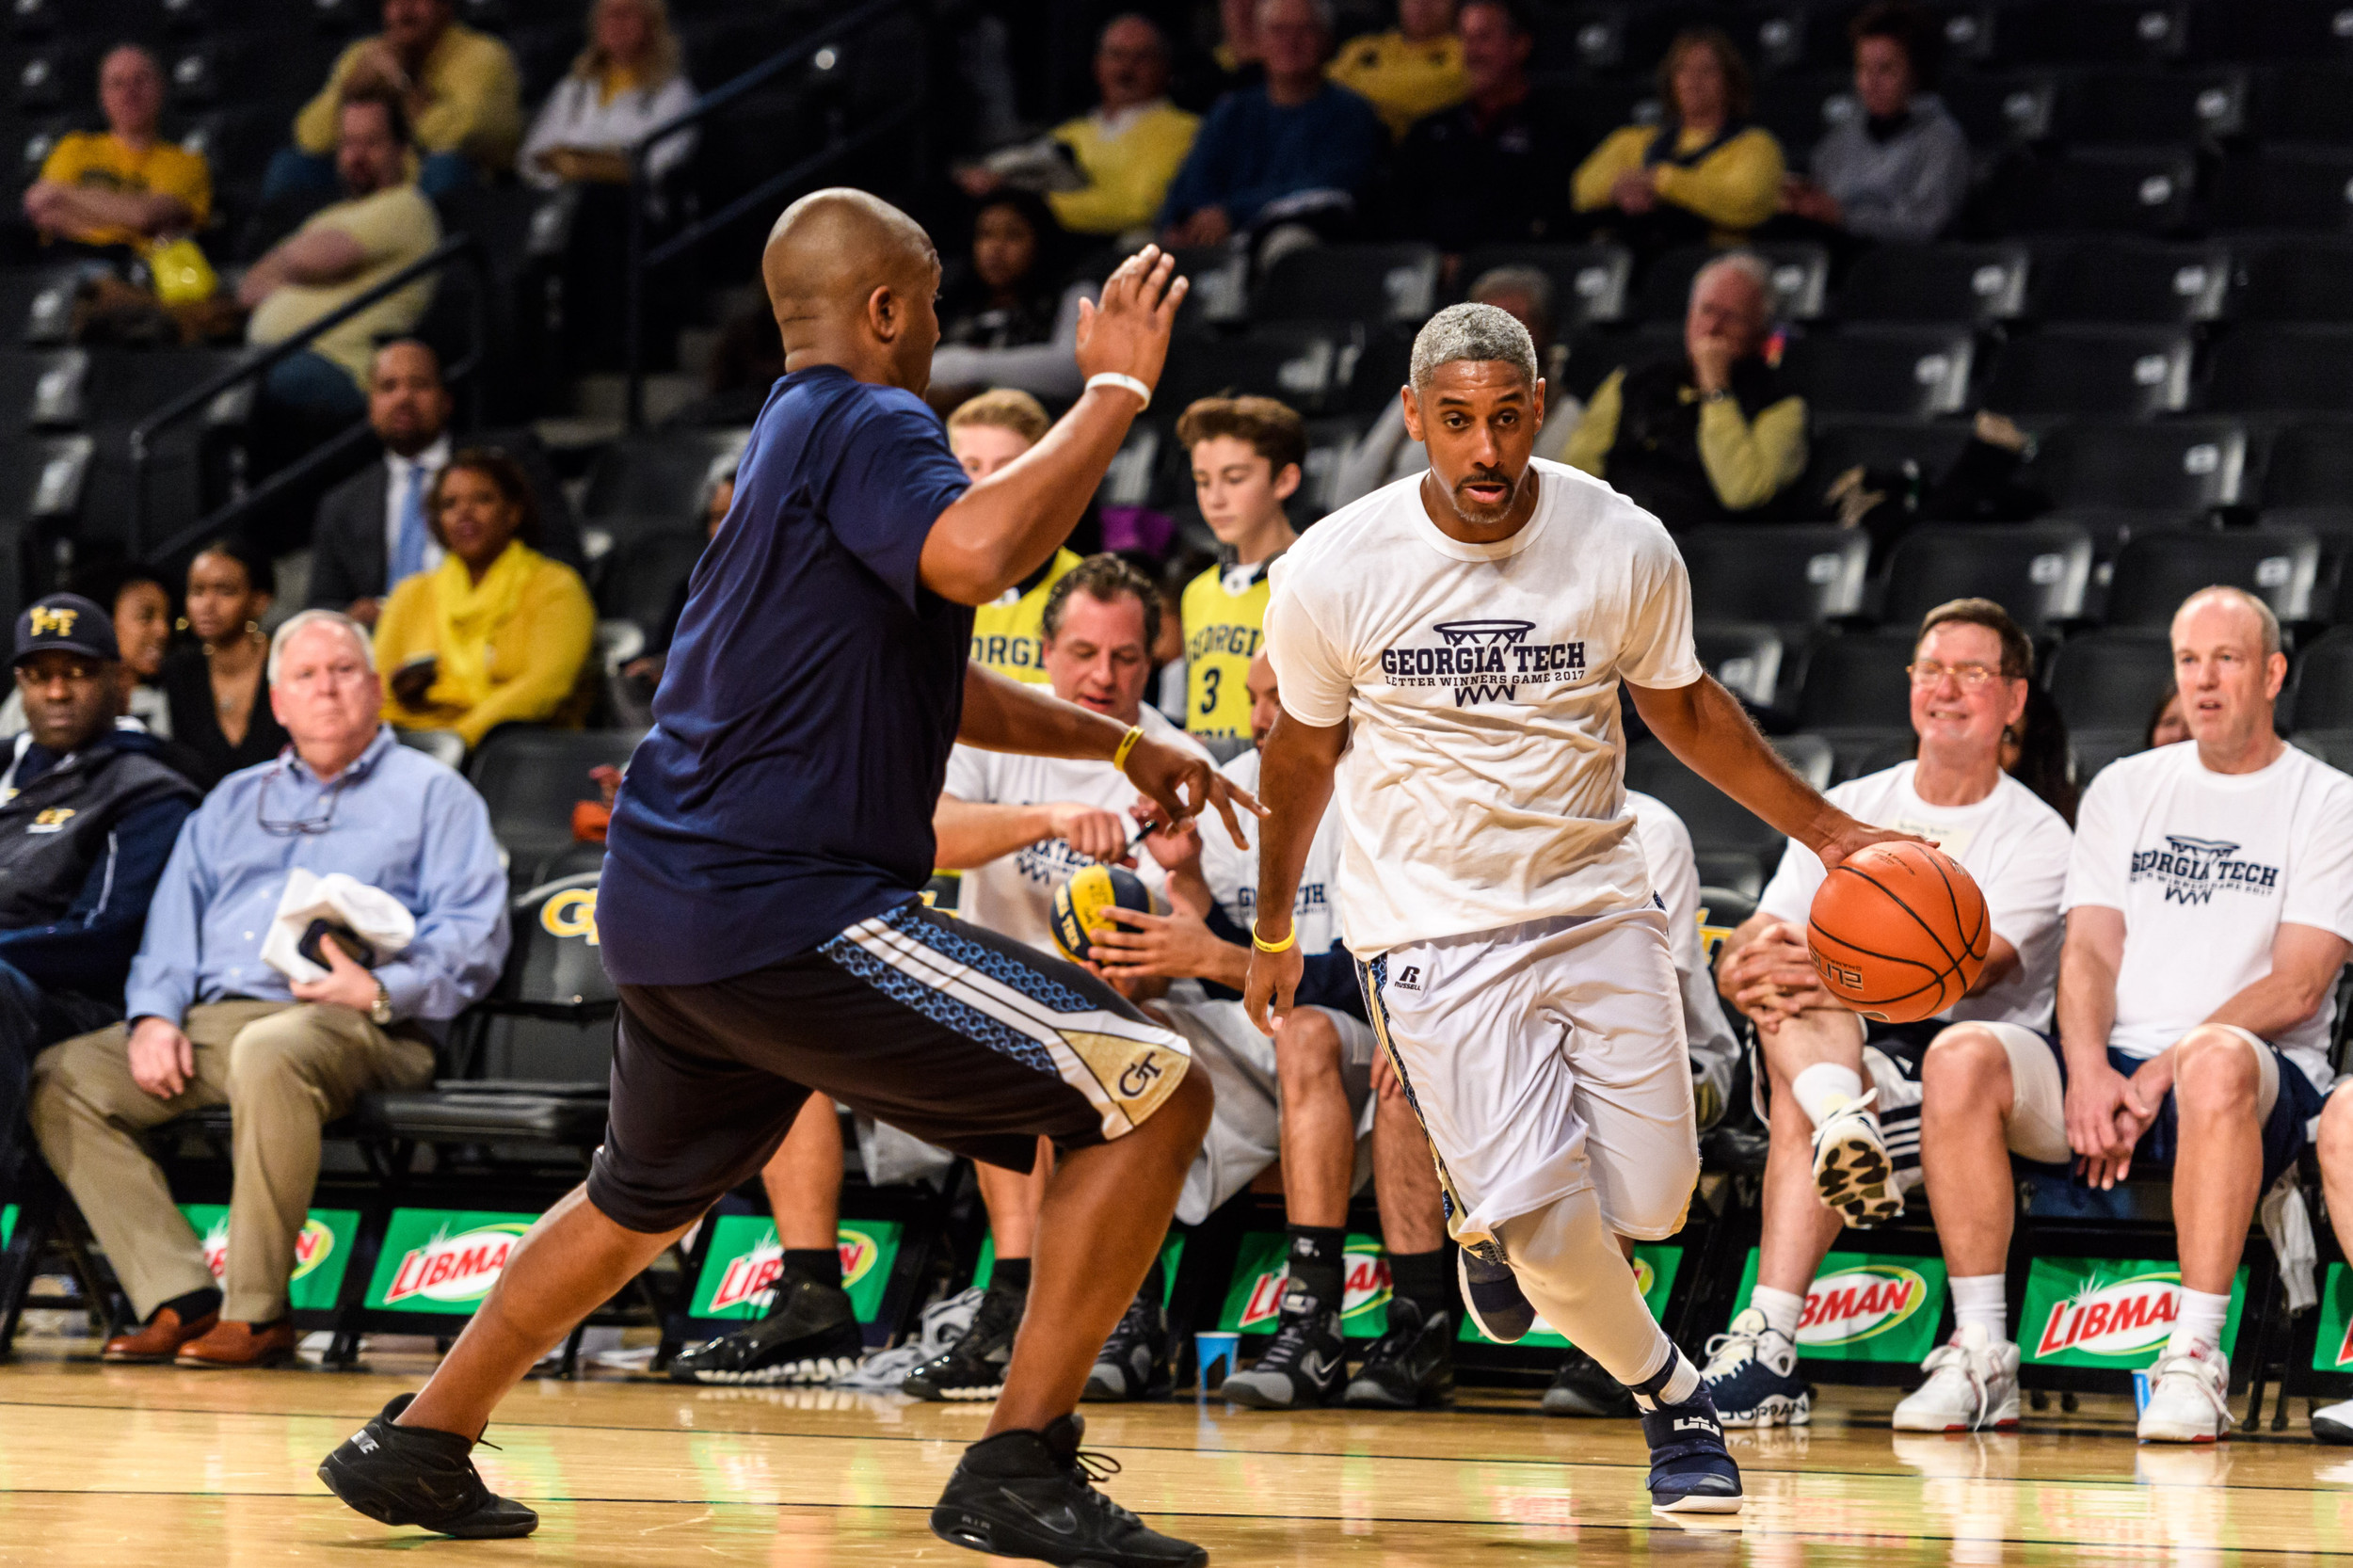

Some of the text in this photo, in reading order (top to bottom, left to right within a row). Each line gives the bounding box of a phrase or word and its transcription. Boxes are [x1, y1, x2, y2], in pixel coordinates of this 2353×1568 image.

[1381, 641, 1586, 676] GEORGIA TECH
[1385, 670, 1585, 687] LETTER WINNERS GAME 2017
[1201, 667, 1220, 713] 3
[2217, 860, 2281, 888] TECH
[1394, 981, 1421, 991] RUSSELL
[1119, 1050, 1161, 1097] GT
[389, 1242, 511, 1298] LIBMA
[715, 1243, 864, 1305] LIBN
[1243, 1258, 1393, 1322] LIAN
[1798, 1280, 1914, 1330] BMAN
[2039, 1290, 2182, 1355] LIBMA
